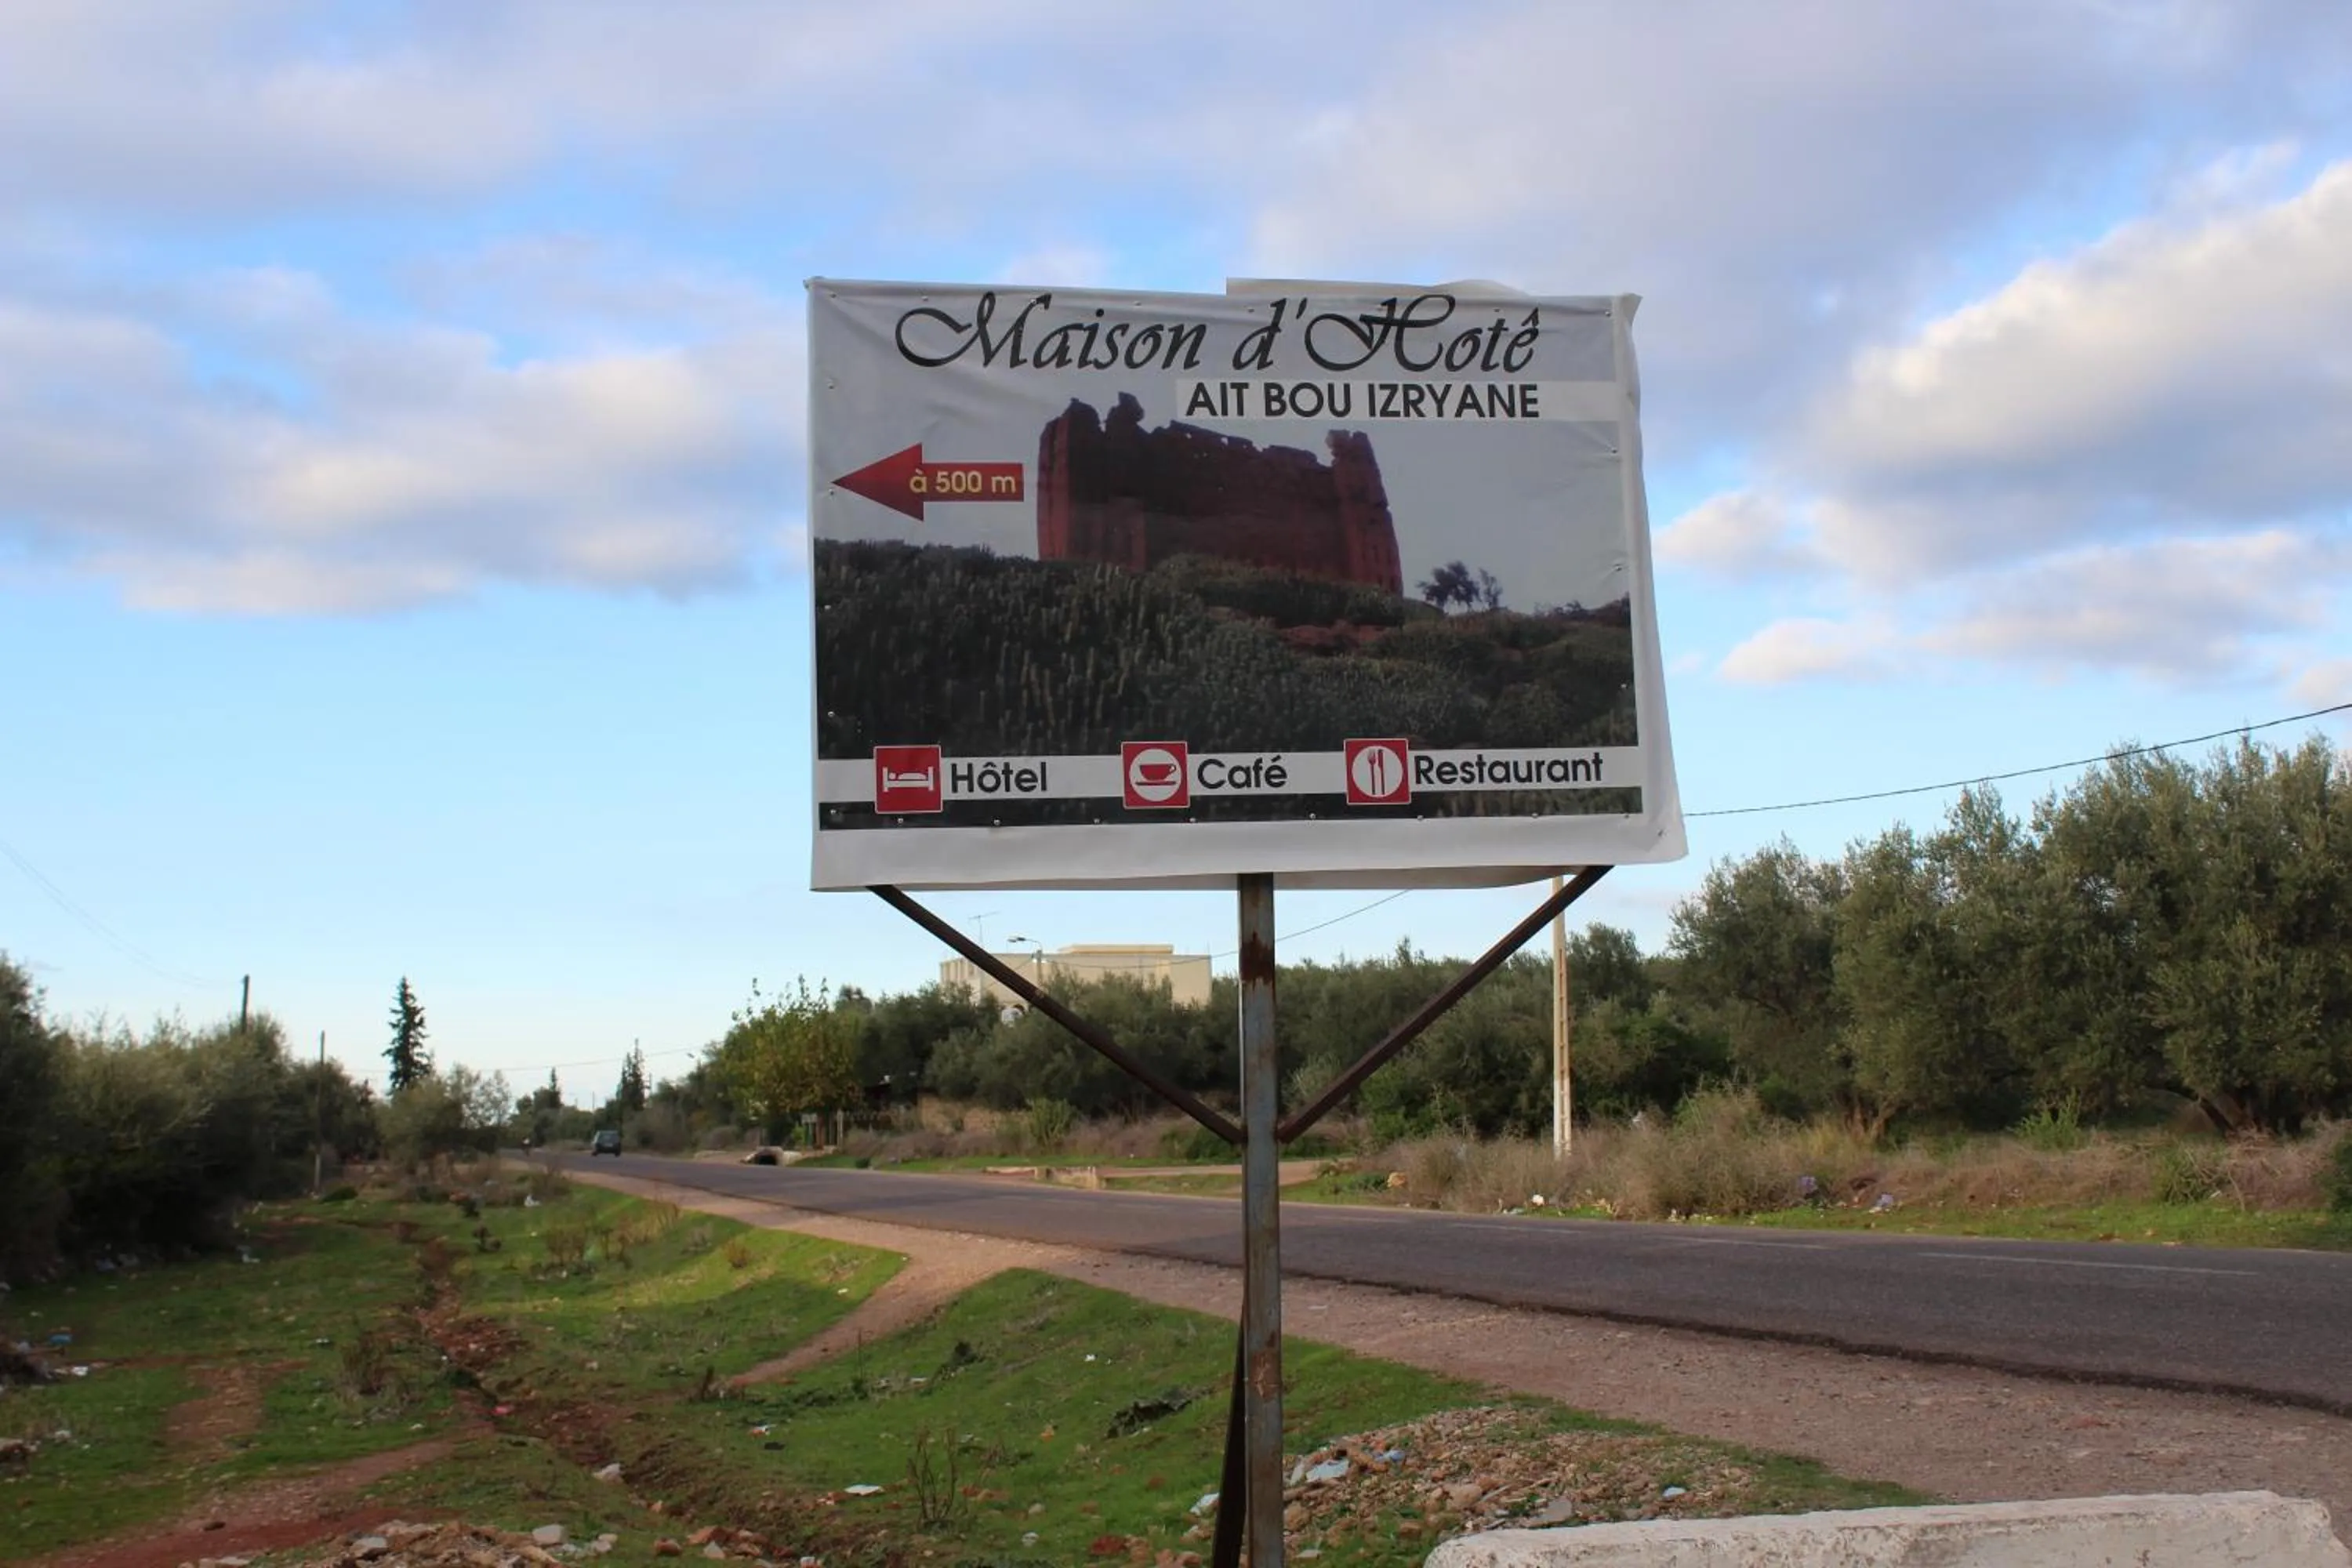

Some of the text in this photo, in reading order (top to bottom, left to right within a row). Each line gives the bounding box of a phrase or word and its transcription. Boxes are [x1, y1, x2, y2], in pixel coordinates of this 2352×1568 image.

[895, 291, 1207, 370] Maison
[1185, 381, 1540, 419] AIT BOU IZRYANE
[909, 467, 1016, 494] à 500 m
[950, 760, 1047, 794] Hôtel
[1196, 753, 1288, 790] Café
[1414, 751, 1603, 786] Restaurant
